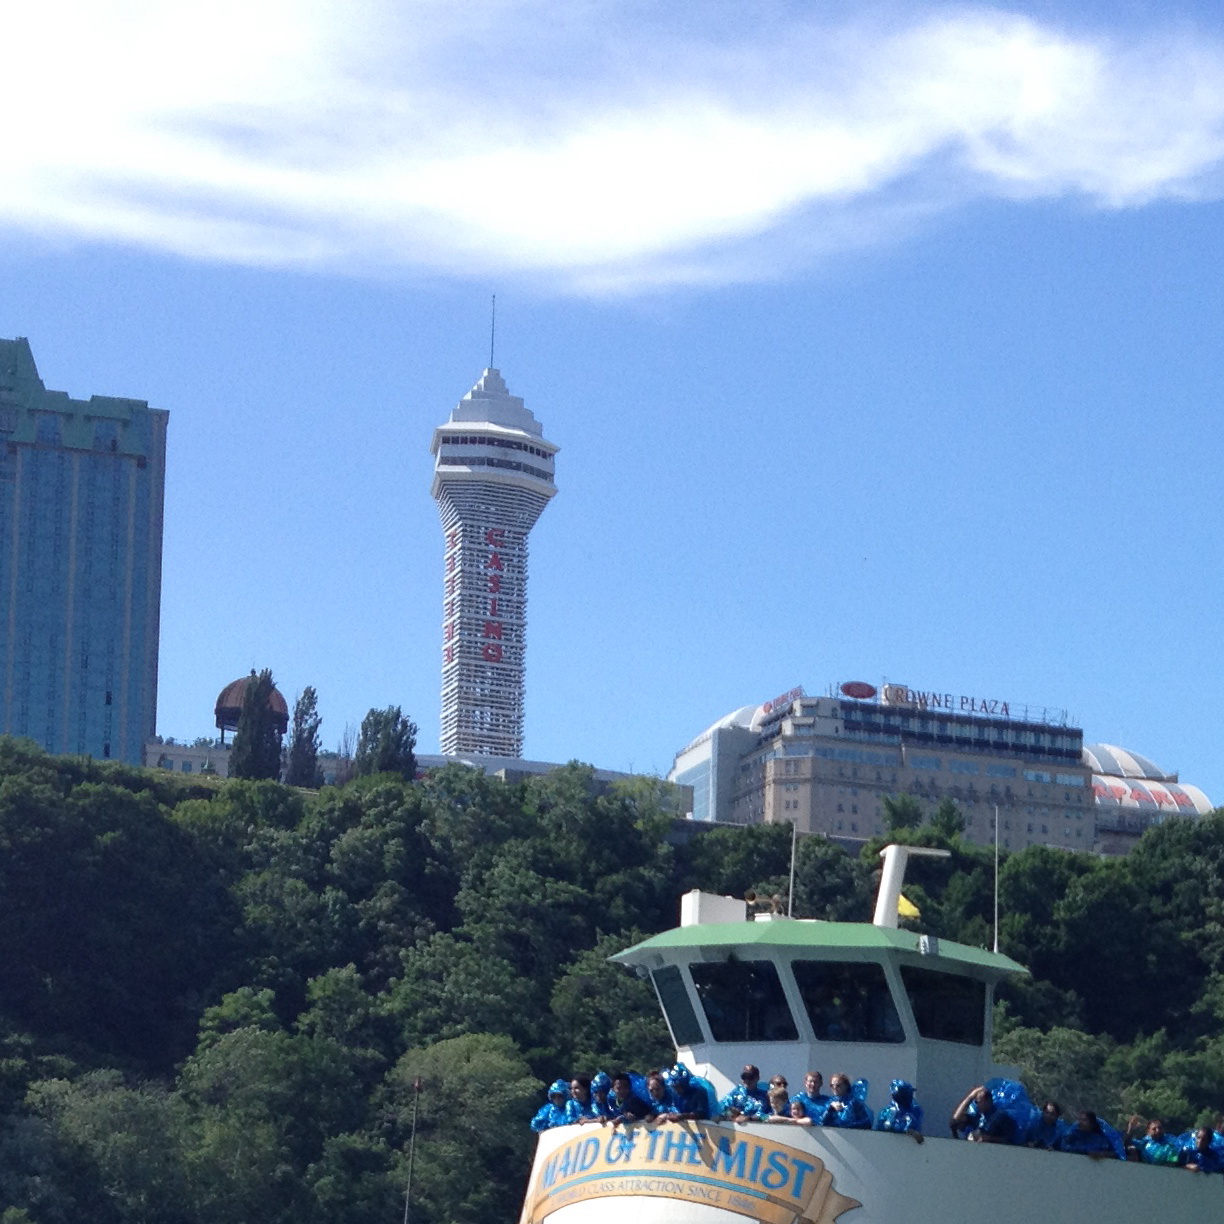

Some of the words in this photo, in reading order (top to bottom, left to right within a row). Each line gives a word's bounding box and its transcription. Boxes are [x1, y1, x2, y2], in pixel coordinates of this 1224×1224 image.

[482, 528, 505, 664] CASINO
[884, 686, 953, 709] CROWNE
[960, 695, 1011, 717] PLAZA
[542, 1136, 601, 1190] MAID
[604, 1130, 641, 1165] OF
[647, 1128, 706, 1165] THE
[710, 1135, 816, 1200] MIST
[618, 1179, 684, 1195] ATTRACTION
